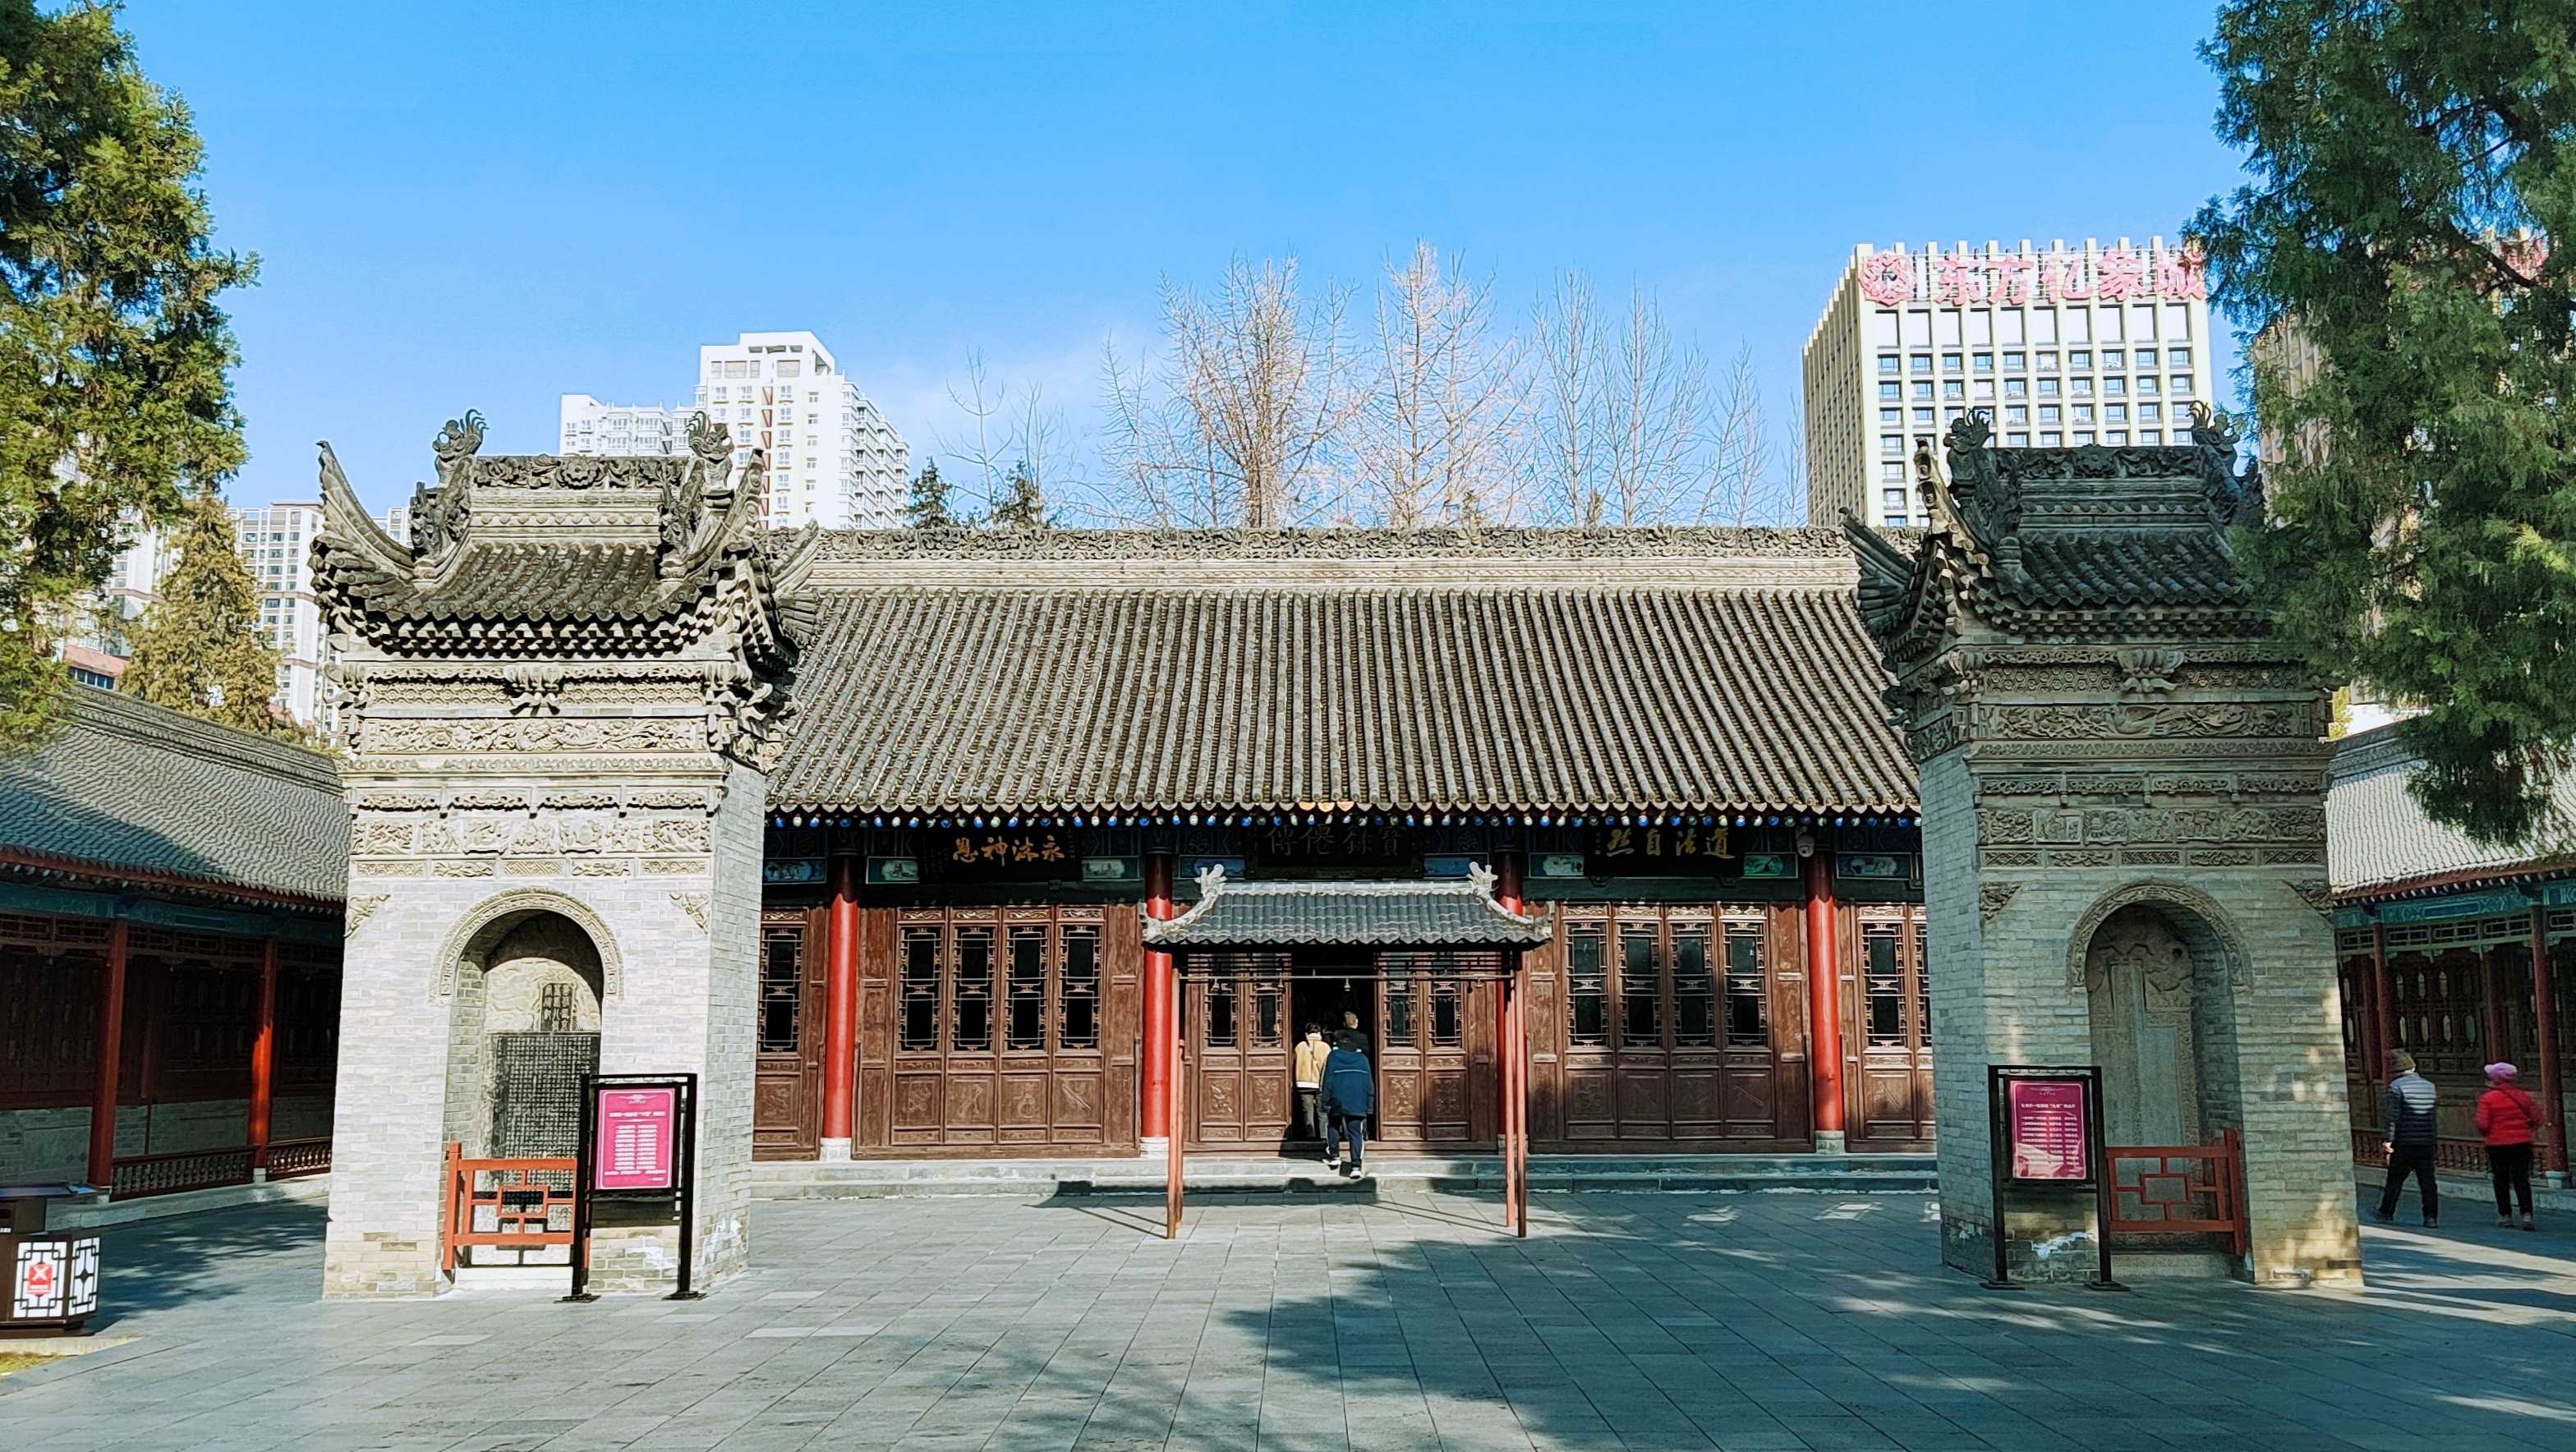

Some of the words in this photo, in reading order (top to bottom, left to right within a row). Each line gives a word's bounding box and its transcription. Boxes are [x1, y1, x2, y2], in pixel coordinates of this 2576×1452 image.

[1934, 250, 2206, 305] 东方亿象城
[952, 834, 1066, 867] 永沐神恩
[1605, 827, 1736, 860] 道法自然
